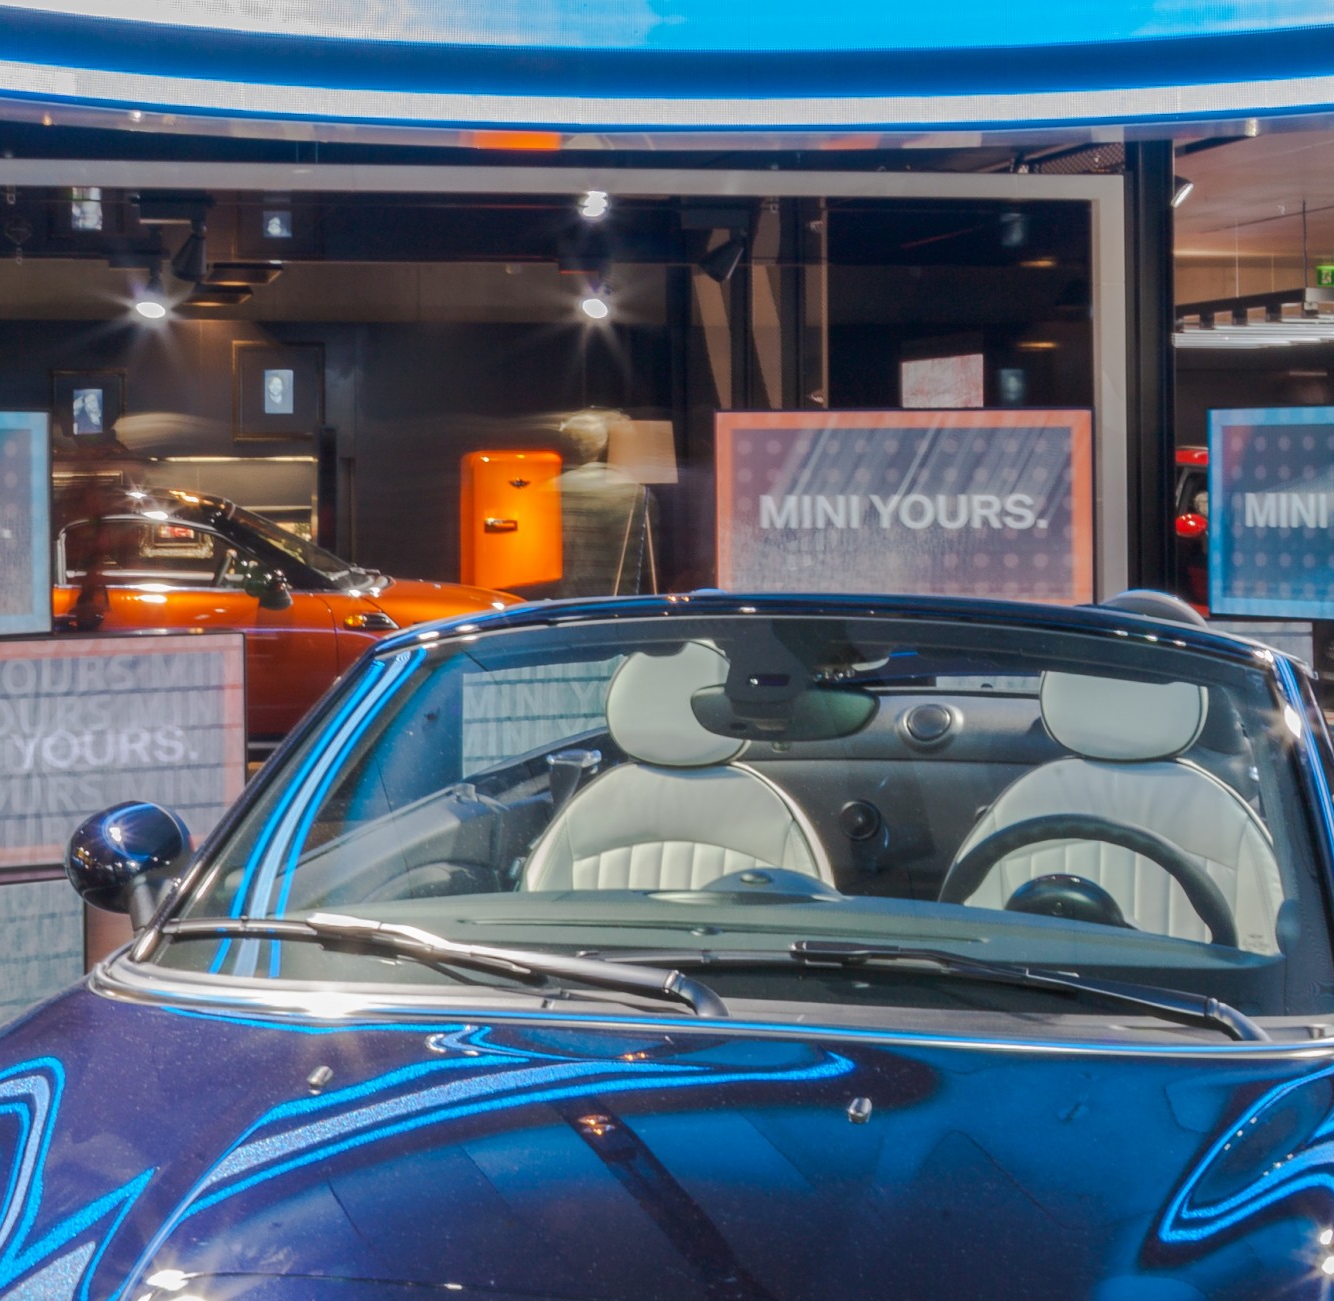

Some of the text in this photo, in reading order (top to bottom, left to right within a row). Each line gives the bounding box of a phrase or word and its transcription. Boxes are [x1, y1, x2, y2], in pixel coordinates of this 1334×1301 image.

[759, 494, 1049, 530] MINI YOURS.
[1244, 492, 1328, 529] MINI
[11, 724, 200, 770] YOURS.
